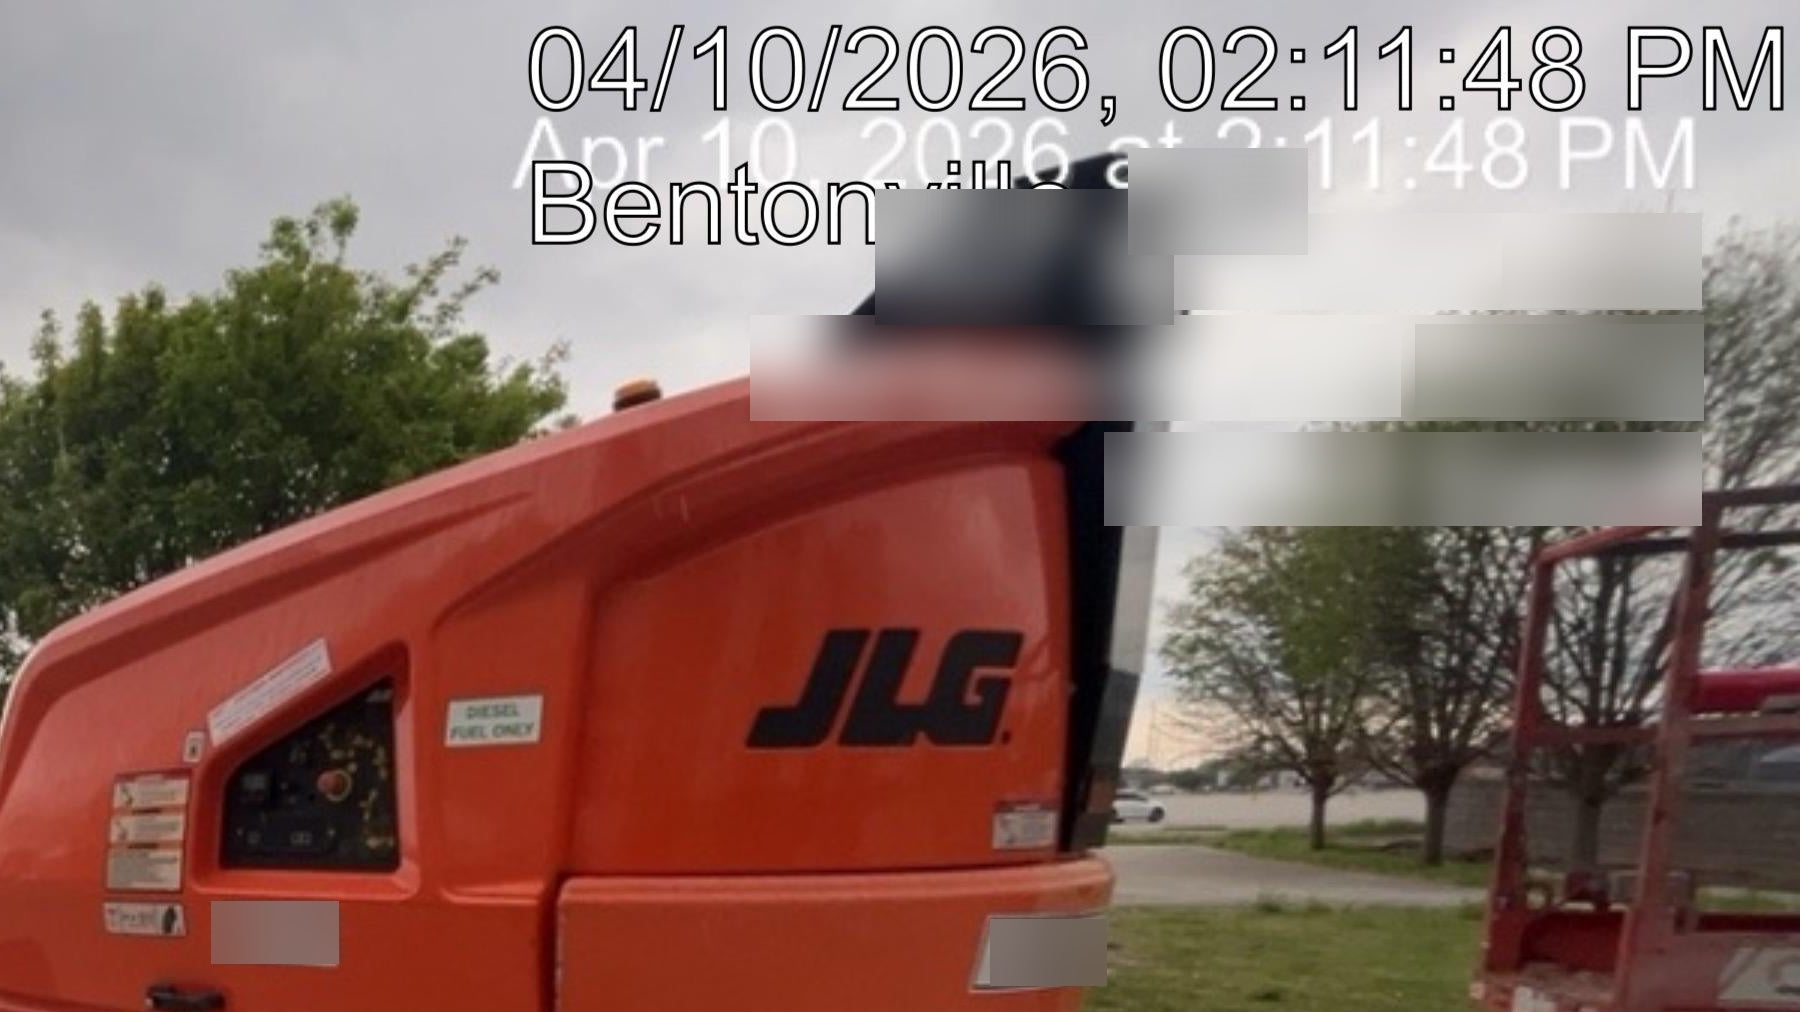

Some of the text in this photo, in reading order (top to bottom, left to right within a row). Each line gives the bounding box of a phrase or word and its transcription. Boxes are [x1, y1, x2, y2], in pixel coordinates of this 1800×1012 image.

[746, 628, 1024, 747] JLG
[465, 703, 519, 720] DIESEL
[450, 722, 535, 740] FUEL ONLY
